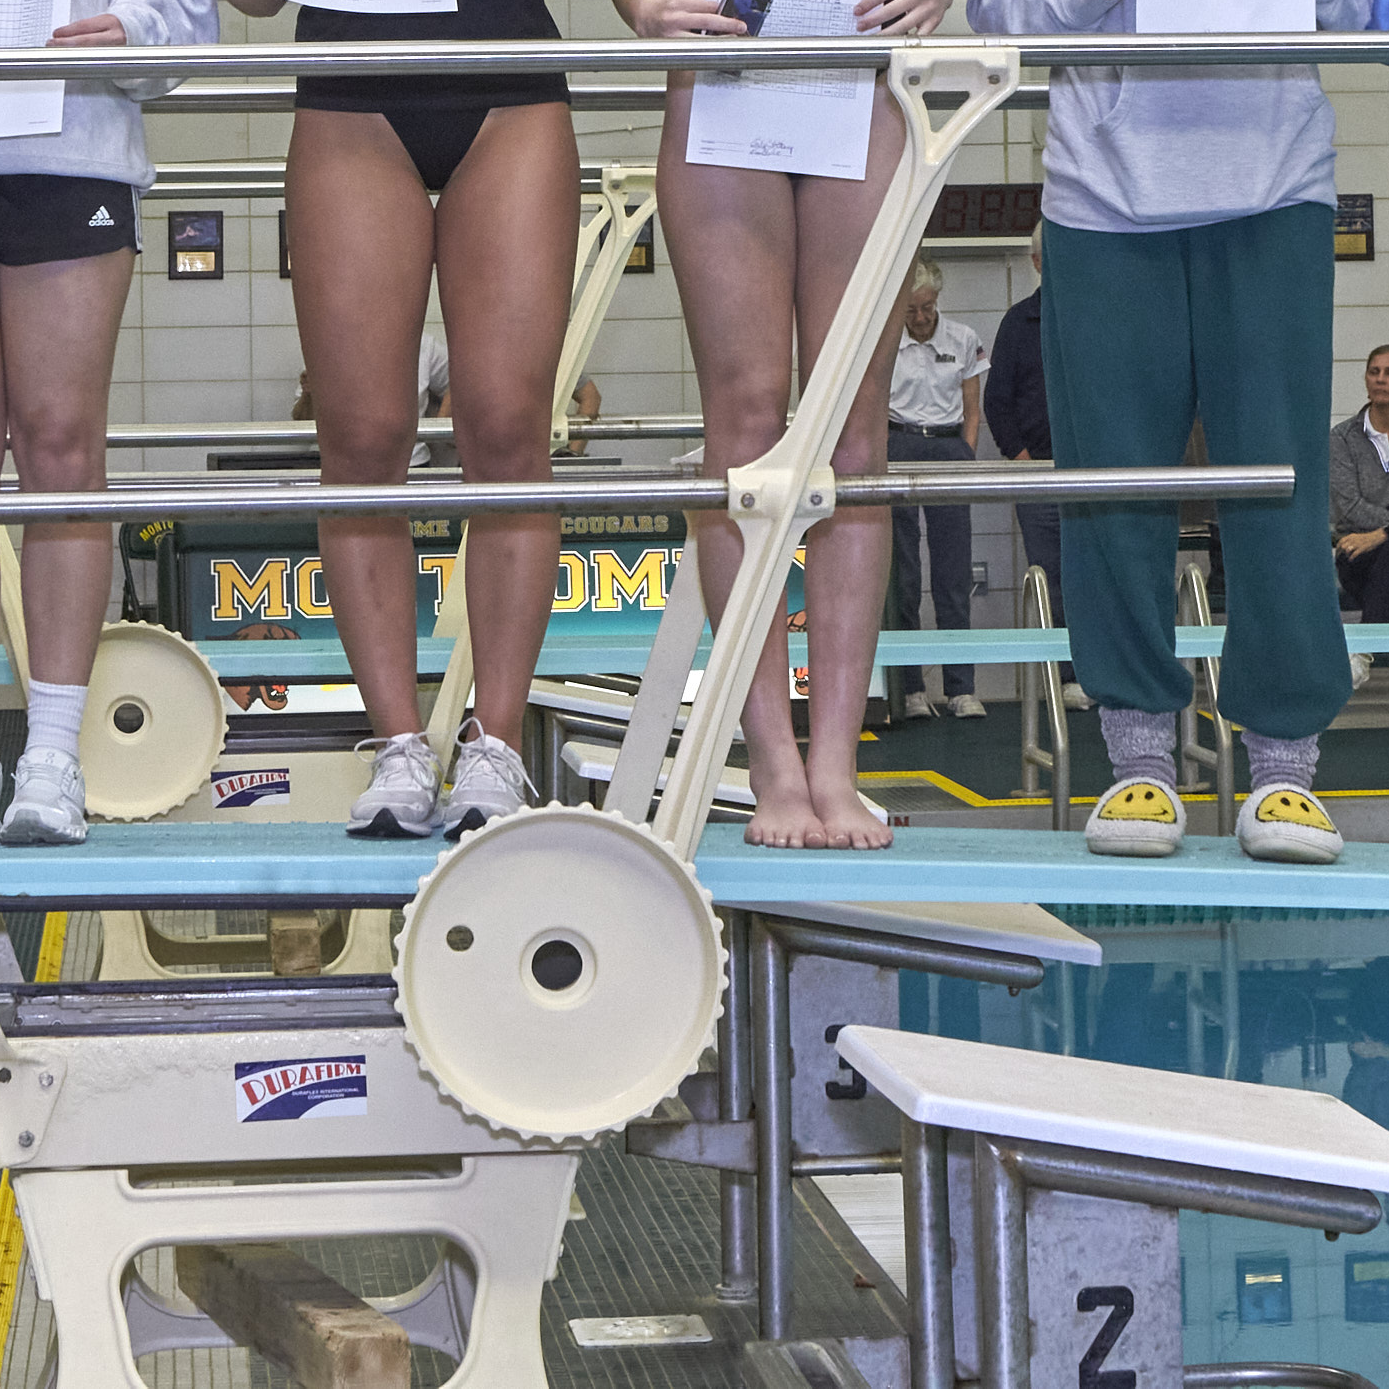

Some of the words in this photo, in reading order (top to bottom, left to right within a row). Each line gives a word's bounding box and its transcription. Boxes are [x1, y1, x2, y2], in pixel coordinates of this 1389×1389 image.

[561, 515, 669, 535] COUGARS
[215, 773, 286, 798] DURAFIRM
[242, 1064, 361, 1106] DURAFIRM
[1077, 1285, 1137, 1389] 2
